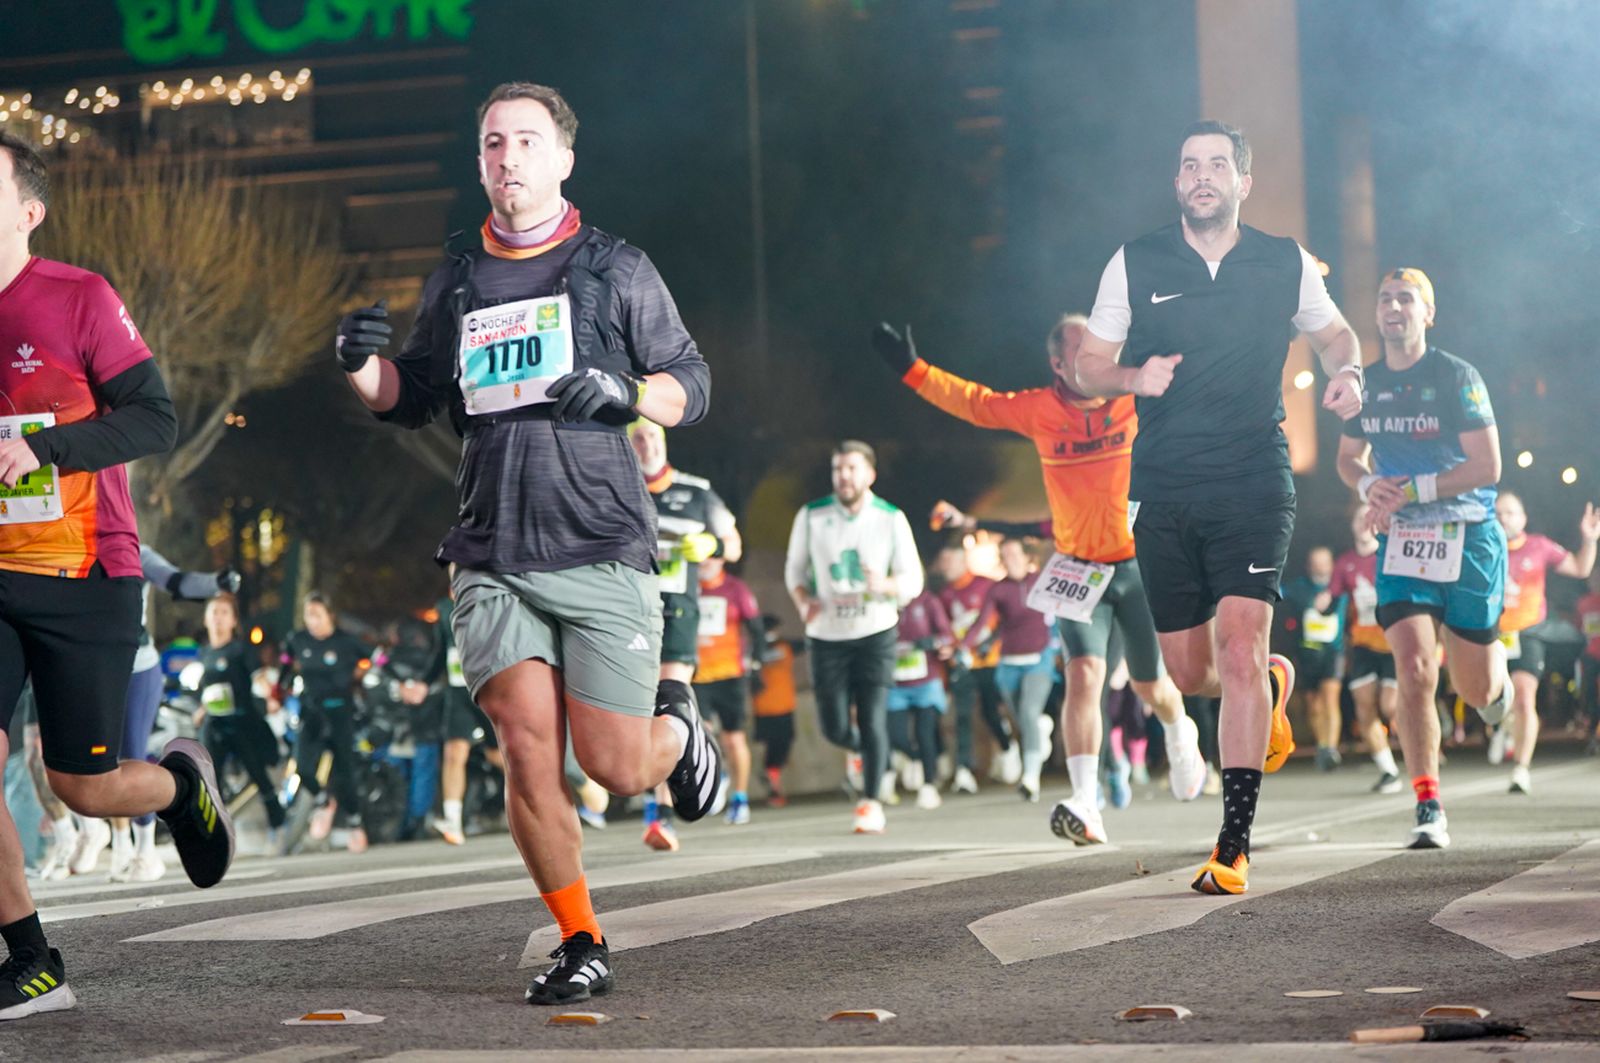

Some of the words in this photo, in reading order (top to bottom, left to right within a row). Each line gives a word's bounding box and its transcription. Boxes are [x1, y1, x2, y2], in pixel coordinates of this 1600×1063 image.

[470, 331, 492, 347] SAN
[485, 336, 542, 374] 1770
[1385, 413, 1440, 433] ANTÓN
[0, 429, 11, 438] DE
[1402, 540, 1447, 560] 6278
[1045, 577, 1090, 602] 2909
